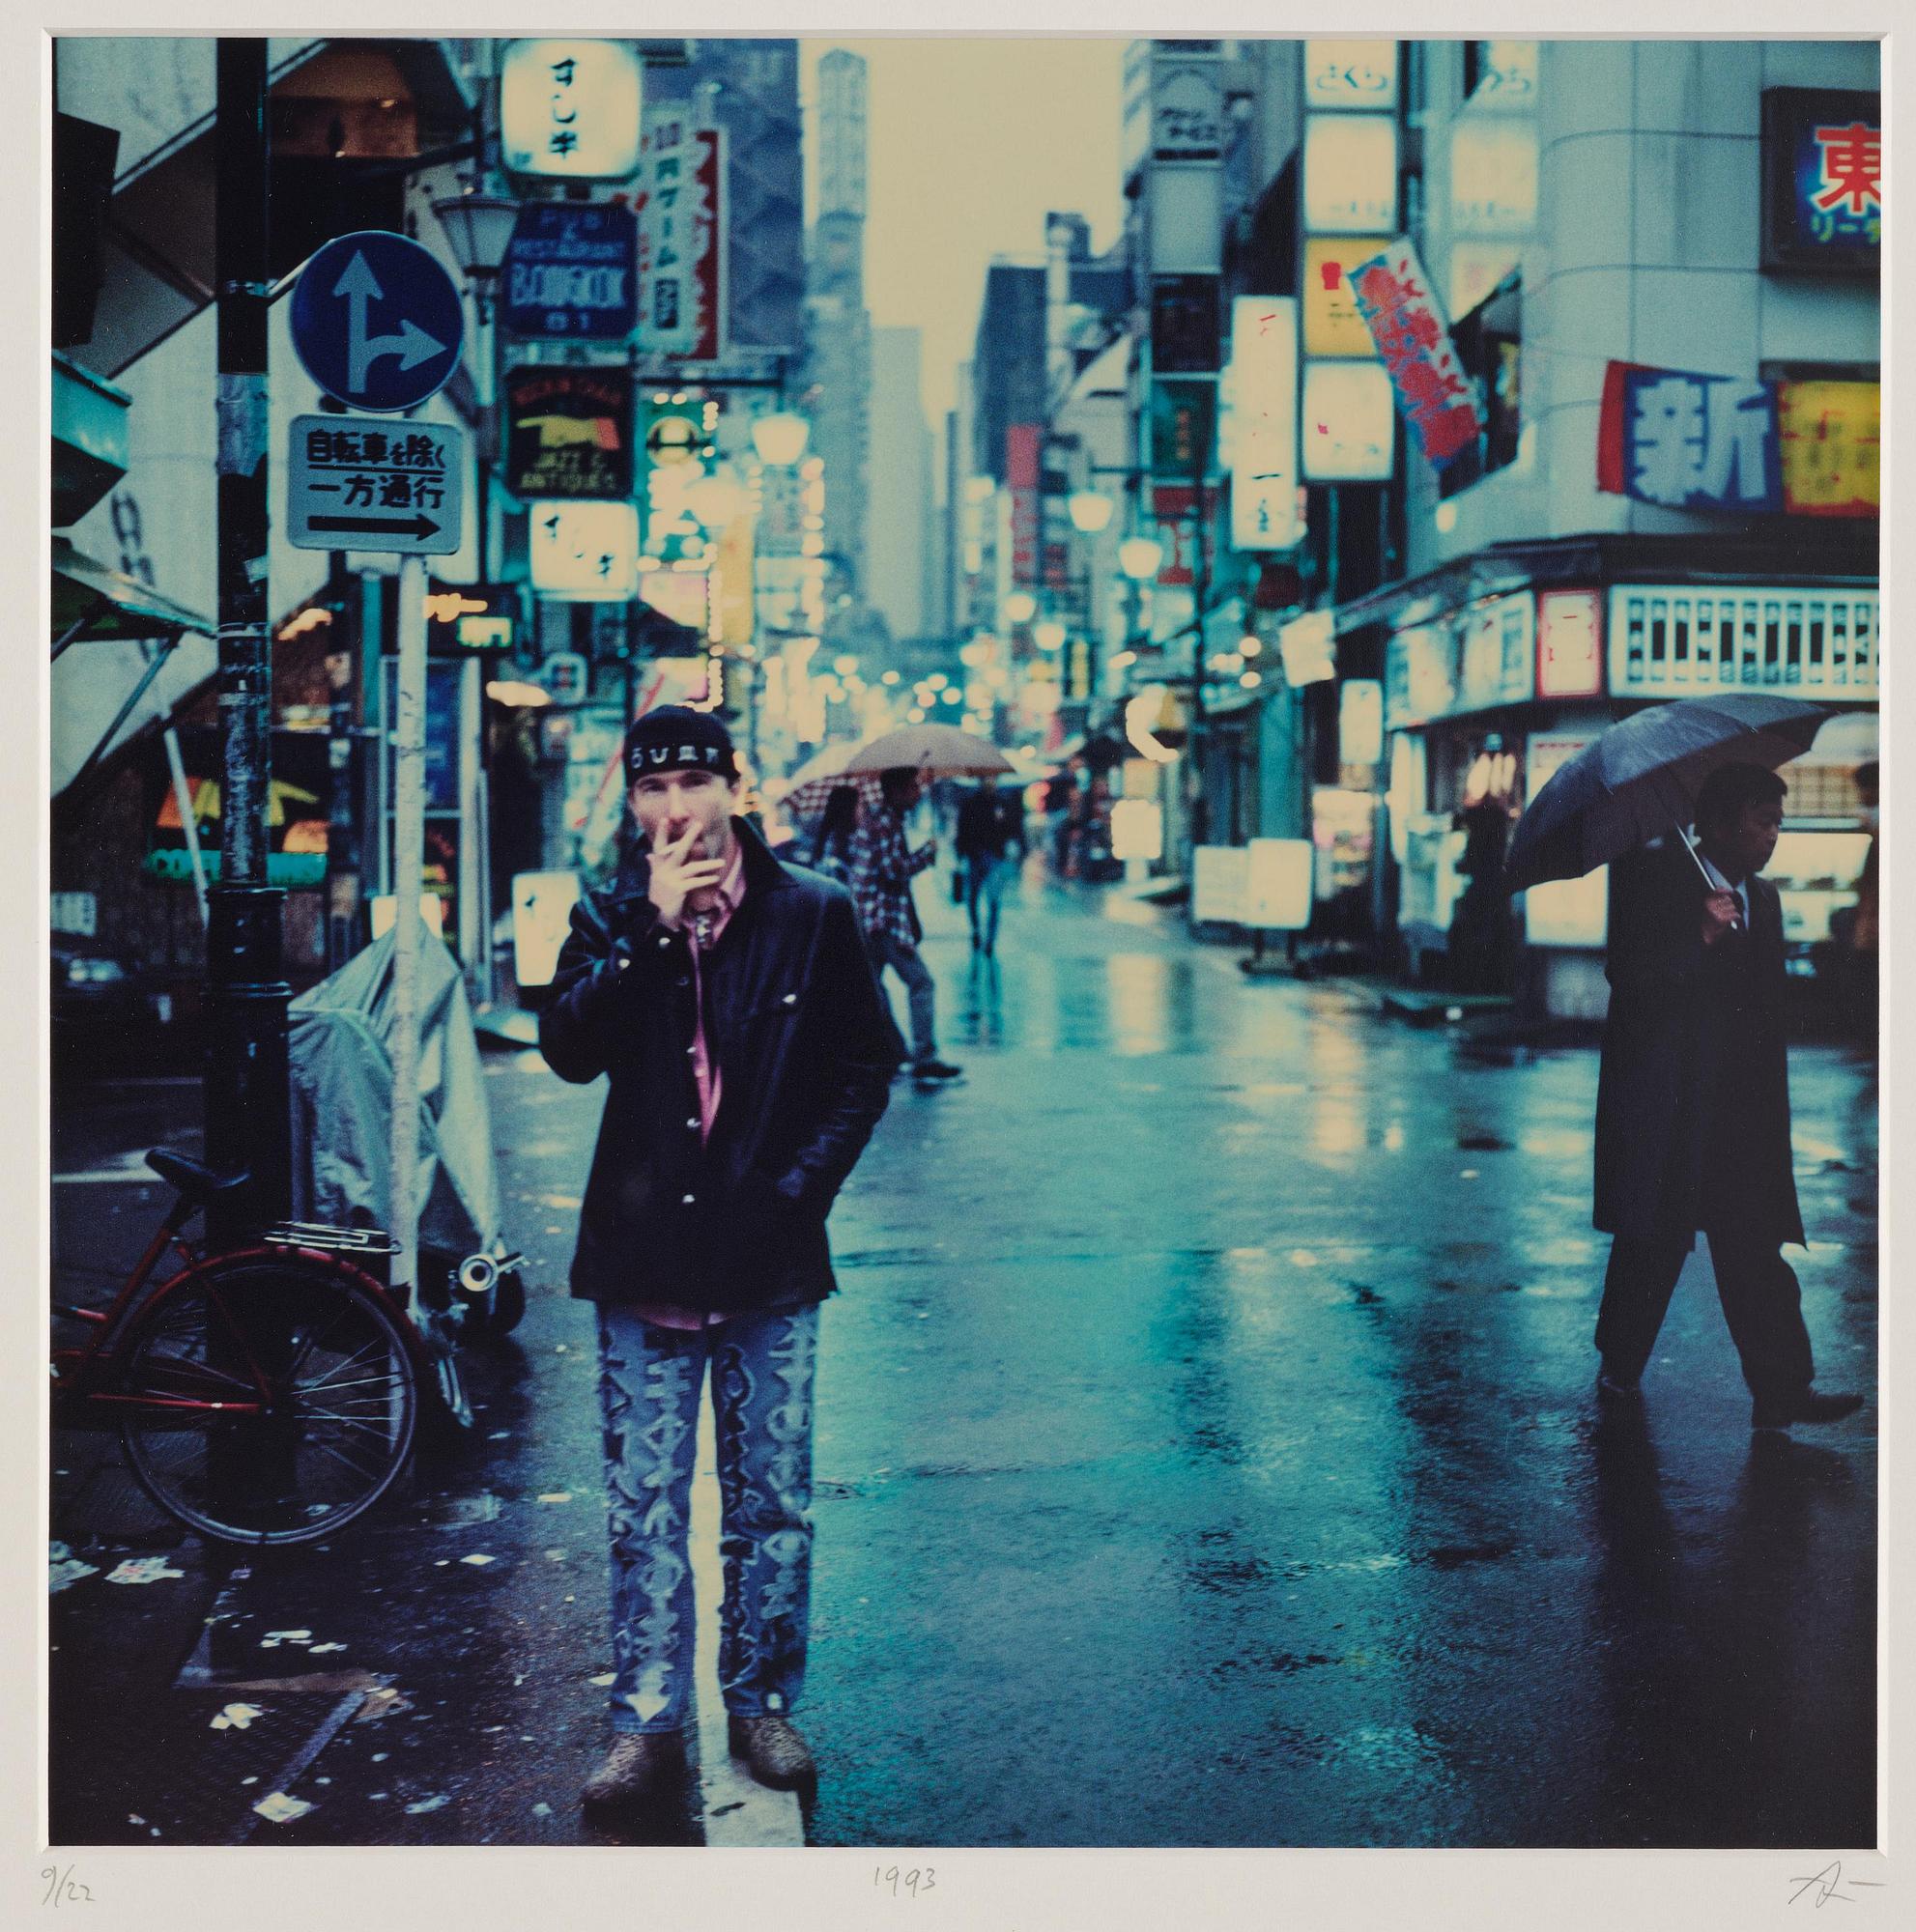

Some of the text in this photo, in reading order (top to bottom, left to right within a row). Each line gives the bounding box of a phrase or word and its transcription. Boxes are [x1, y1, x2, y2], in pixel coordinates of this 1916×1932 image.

[1813, 122, 1881, 215] 東
[306, 428, 446, 469] 自転車を除く
[307, 473, 446, 510] 一方通行
[41, 1862, 97, 1909] 9/22
[874, 1865, 936, 1898] 1993
